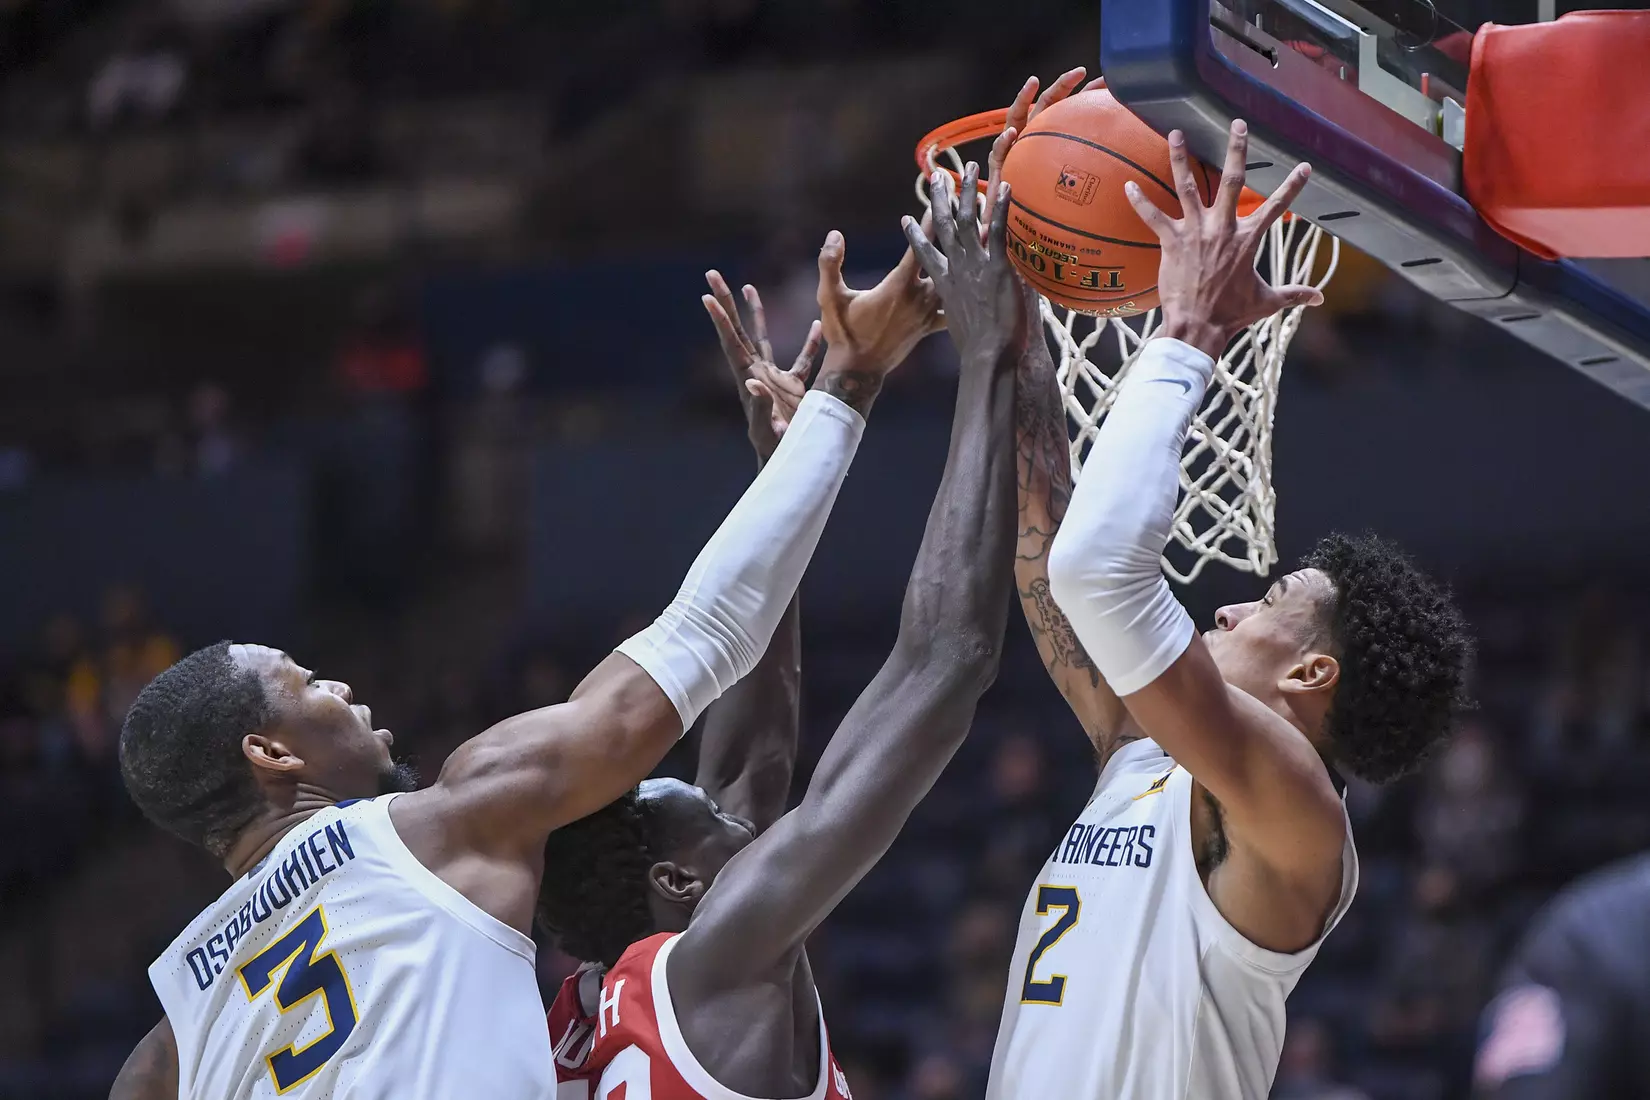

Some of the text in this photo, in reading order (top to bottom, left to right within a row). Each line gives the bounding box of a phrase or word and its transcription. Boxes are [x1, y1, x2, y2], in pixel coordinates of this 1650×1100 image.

[1028, 241, 1079, 265] LEGACY
[1040, 233, 1076, 251] CHANNEL
[1052, 823, 1156, 868] AINEERS
[186, 819, 355, 991] OSABUOHIEN
[1020, 884, 1082, 1007] 2
[236, 903, 359, 1096] 3
